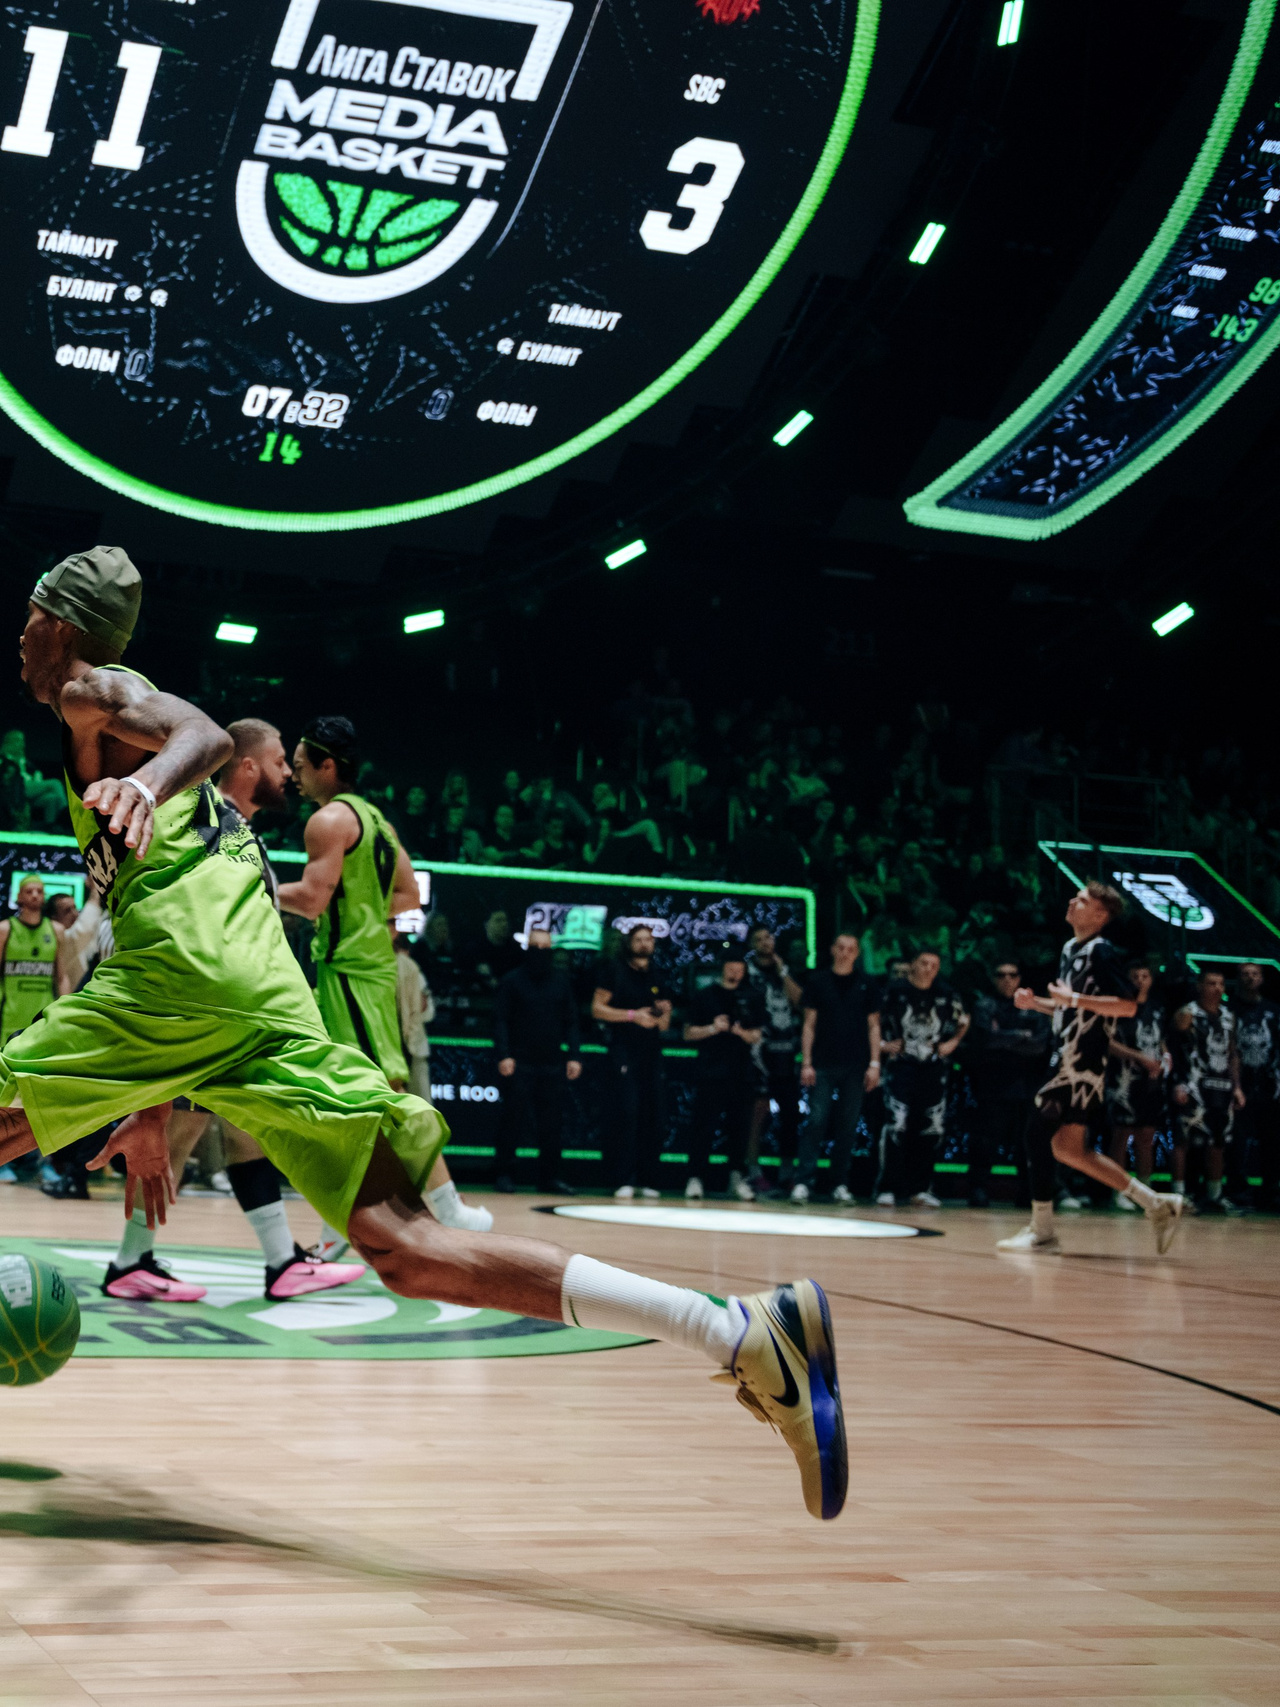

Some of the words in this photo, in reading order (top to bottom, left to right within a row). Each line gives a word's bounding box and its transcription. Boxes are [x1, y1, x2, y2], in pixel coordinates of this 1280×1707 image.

[1, 26, 162, 171] 11
[683, 73, 726, 105] SBC
[265, 78, 508, 155] MEDIA
[254, 123, 506, 189] BASKET
[639, 136, 745, 255] 3
[37, 229, 118, 260] ТАЙМАУТ
[46, 275, 118, 303] БУЛЛИТ
[548, 303, 622, 331] ТАЙМАУТ
[1210, 314, 1259, 343] 143
[55, 344, 121, 373] ФОЛЫ
[516, 341, 583, 367] БУЛЛИТ
[241, 384, 351, 429] 07:32
[476, 400, 538, 427] ФОЛЫ
[258, 431, 303, 465] 14
[430, 1083, 456, 1101] HE
[459, 1084, 500, 1103] ROO
